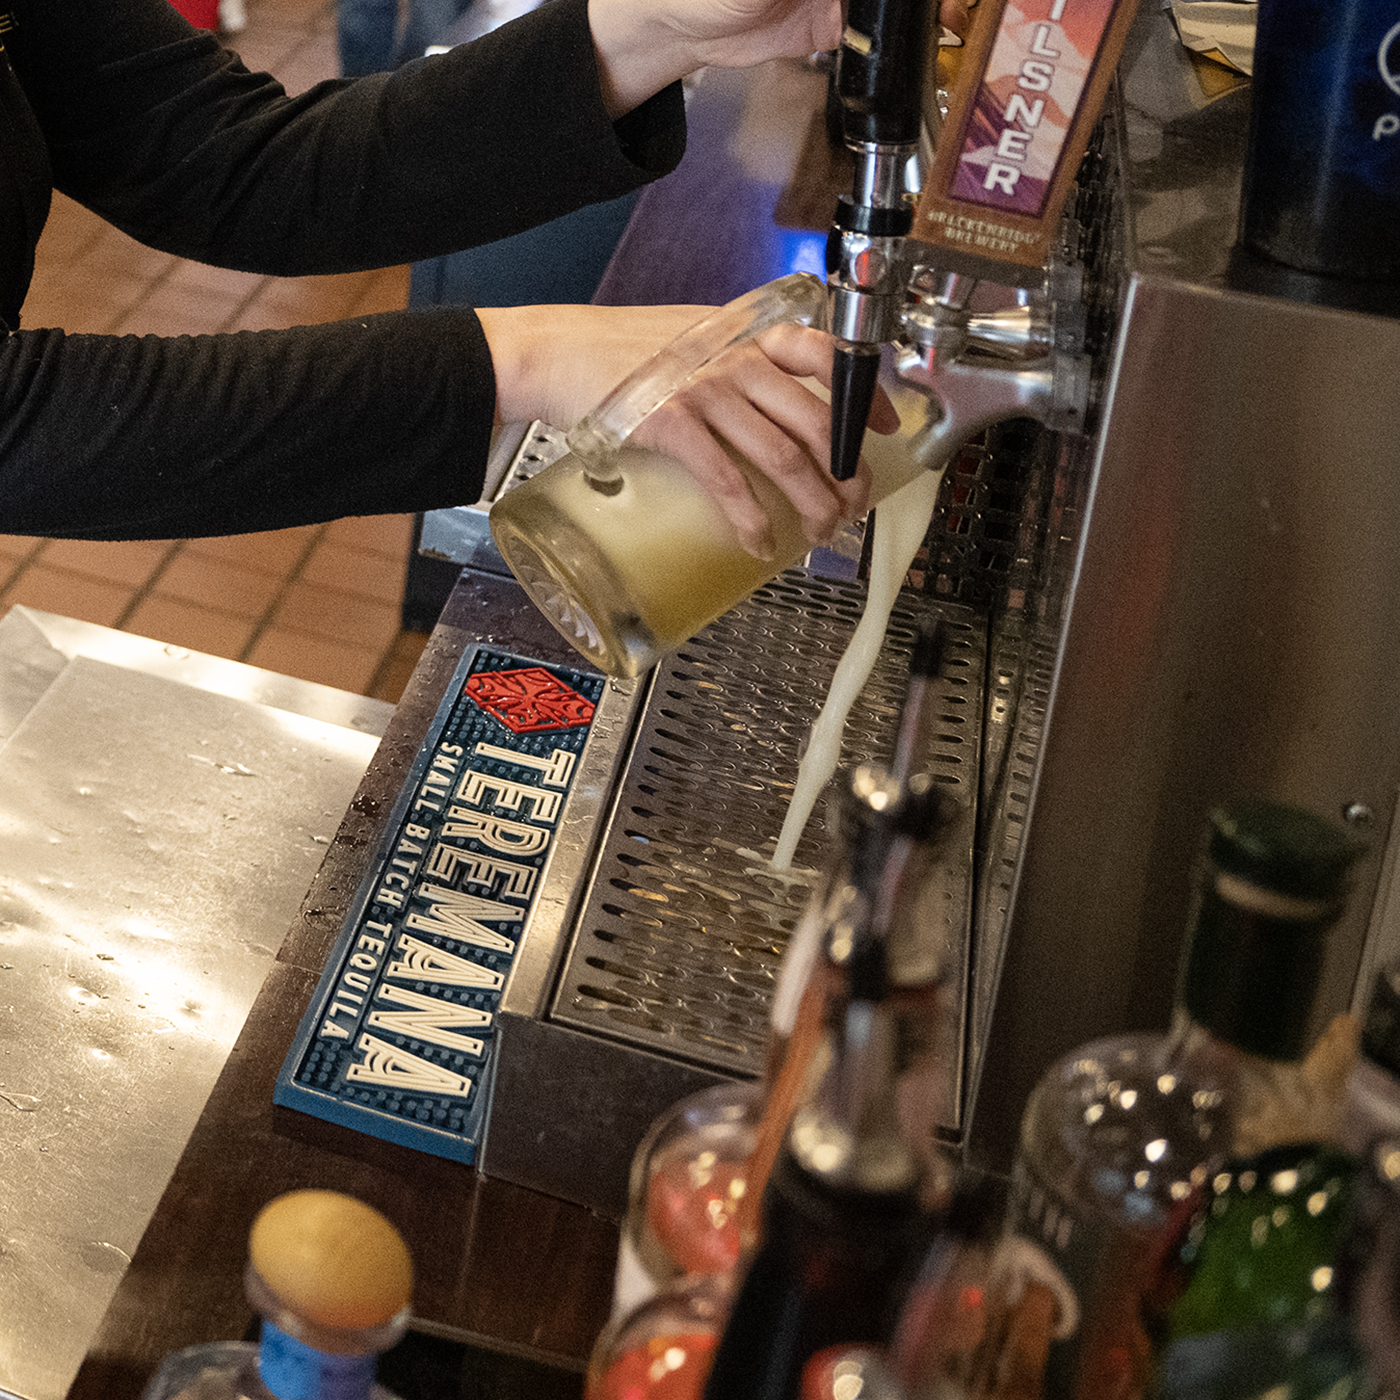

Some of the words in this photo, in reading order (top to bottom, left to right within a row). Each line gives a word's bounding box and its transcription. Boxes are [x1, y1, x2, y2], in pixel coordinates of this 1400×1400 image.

[411, 741, 464, 816] SMALL
[374, 821, 432, 908] BATCH
[347, 741, 579, 1099] TEREMANA
[321, 921, 395, 1042] TEQUILA
